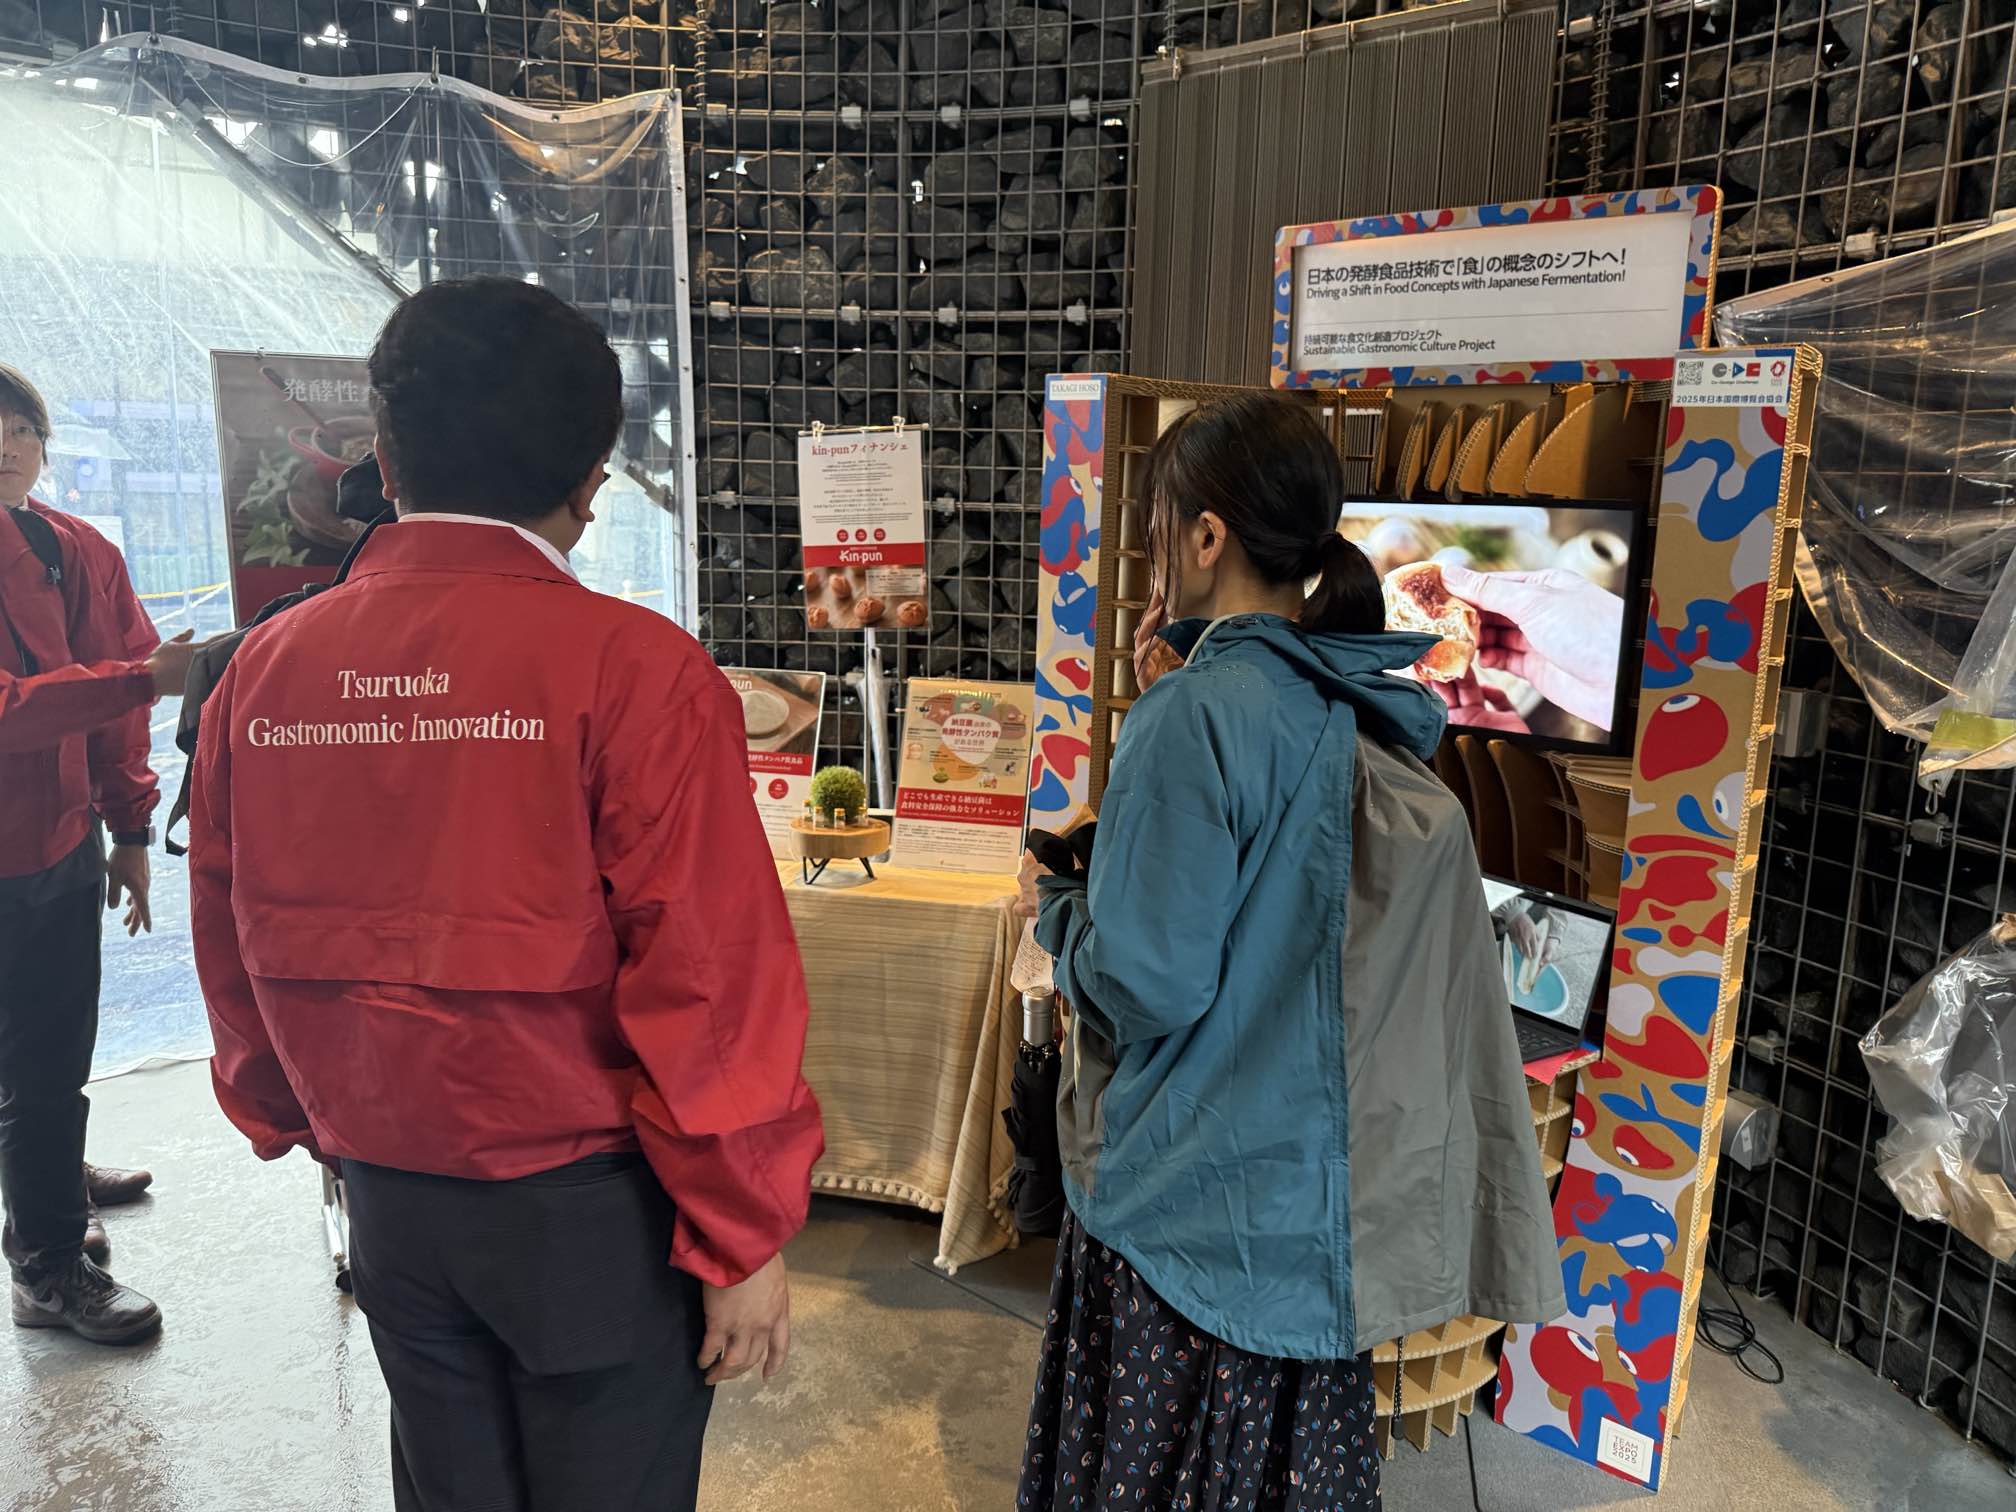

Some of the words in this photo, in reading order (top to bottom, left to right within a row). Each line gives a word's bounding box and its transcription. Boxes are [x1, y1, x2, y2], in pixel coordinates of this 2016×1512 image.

[1307, 286, 1340, 300] Driving
[1341, 287, 1347, 296] a
[1350, 284, 1371, 296] Shift
[1373, 282, 1382, 295] in
[1384, 281, 1409, 294] Food
[1411, 279, 1459, 294] Concepts
[1462, 277, 1485, 290] with
[1487, 276, 1539, 291] Japanese
[1541, 269, 1626, 286] Fermentation!
[1304, 343, 1355, 356] Sustainable
[1357, 341, 1418, 354] Gastronomic
[1420, 339, 1456, 351] Culture
[1458, 338, 1495, 352] Project
[283, 379, 368, 402] 発酵性
[337, 667, 449, 699] Tsuruoka
[248, 714, 404, 746] Gastronomic
[409, 709, 545, 742] Innovation
[1612, 1450, 1637, 1463] 2025
[1613, 1441, 1638, 1458] EXPO
